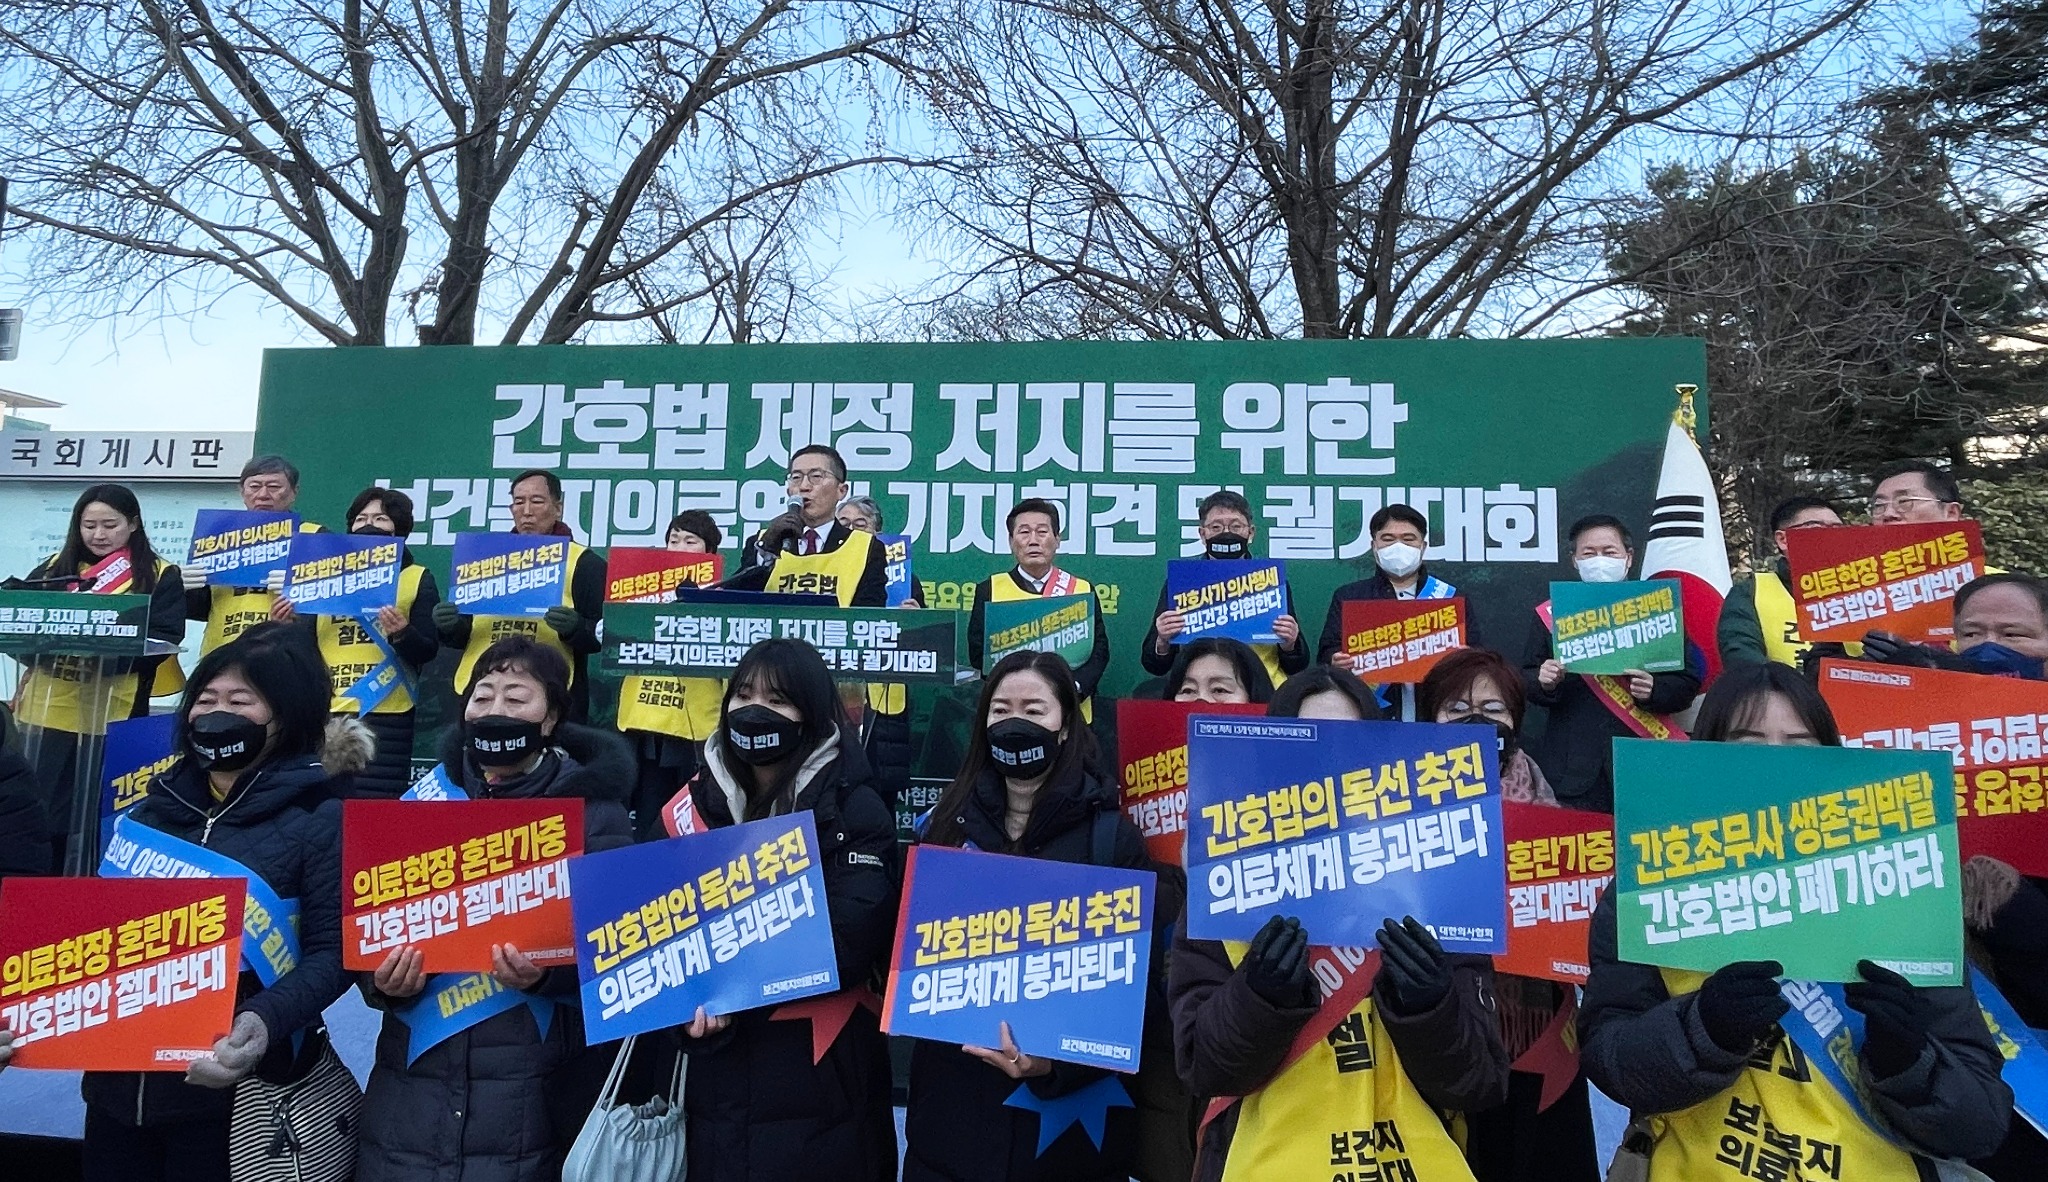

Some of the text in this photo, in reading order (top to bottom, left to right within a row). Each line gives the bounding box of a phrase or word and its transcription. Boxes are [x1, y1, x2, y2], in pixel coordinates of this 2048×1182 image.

[492, 377, 1408, 476] 간호법 제정 저지를 위한
[193, 518, 294, 558] 간호사가 의사행세
[1263, 483, 1559, 563] 궐기대회
[288, 563, 395, 605] 의료체계 붕괴된다
[291, 542, 398, 585] 간호법안 독선 추진
[454, 565, 561, 606] 의료체계 붕괴된다
[455, 543, 564, 585] 간호법안 독선 추진
[609, 575, 660, 600] 의료현장
[1173, 566, 1279, 614] 간호사가 의사행세
[1799, 531, 1970, 600] 의료현장 혼란가중
[1805, 561, 1976, 632] 간호법안 절대반대
[491, 620, 538, 634] 보건복지
[654, 616, 902, 649] 간호법 제정 저지를 위한
[1347, 604, 1459, 654] 의료현장 혼란가중
[1557, 611, 1678, 665] 간호법안 폐기하라
[617, 642, 751, 668] 보건복지의료연
[840, 649, 859, 671] 및
[862, 650, 937, 673] 궐기대회
[1350, 642, 1405, 677] 간호법안
[636, 691, 686, 711] 의료연대
[1969, 712, 2048, 766] 법안
[1201, 742, 1487, 858] 간호법의 독선 추진
[1973, 766, 2048, 818] 현장
[1630, 805, 1784, 885] 간호조무사
[1788, 771, 1937, 856] 생존권박탈
[352, 813, 567, 908] 의료현장 혼란가중
[1208, 803, 1489, 915] 의료체계 붕괴된다
[1506, 830, 1614, 882] 혼란가중
[353, 858, 572, 956] 간호법안 절대반대
[586, 826, 811, 974] 간호법안 독선 추진
[1638, 832, 1946, 945] 간호법안 폐기하라
[1, 894, 227, 998] 의료현장 혼란가중
[598, 927, 712, 1022] 의료체계
[710, 875, 817, 965] 붕괴된다
[914, 885, 1142, 968] 간호법안 독선 추진
[1439, 925, 1494, 938] 대한의사협회
[1, 943, 227, 1049] 간호법안 절대반대
[908, 937, 1137, 1016] 의료체계 붕괴된다
